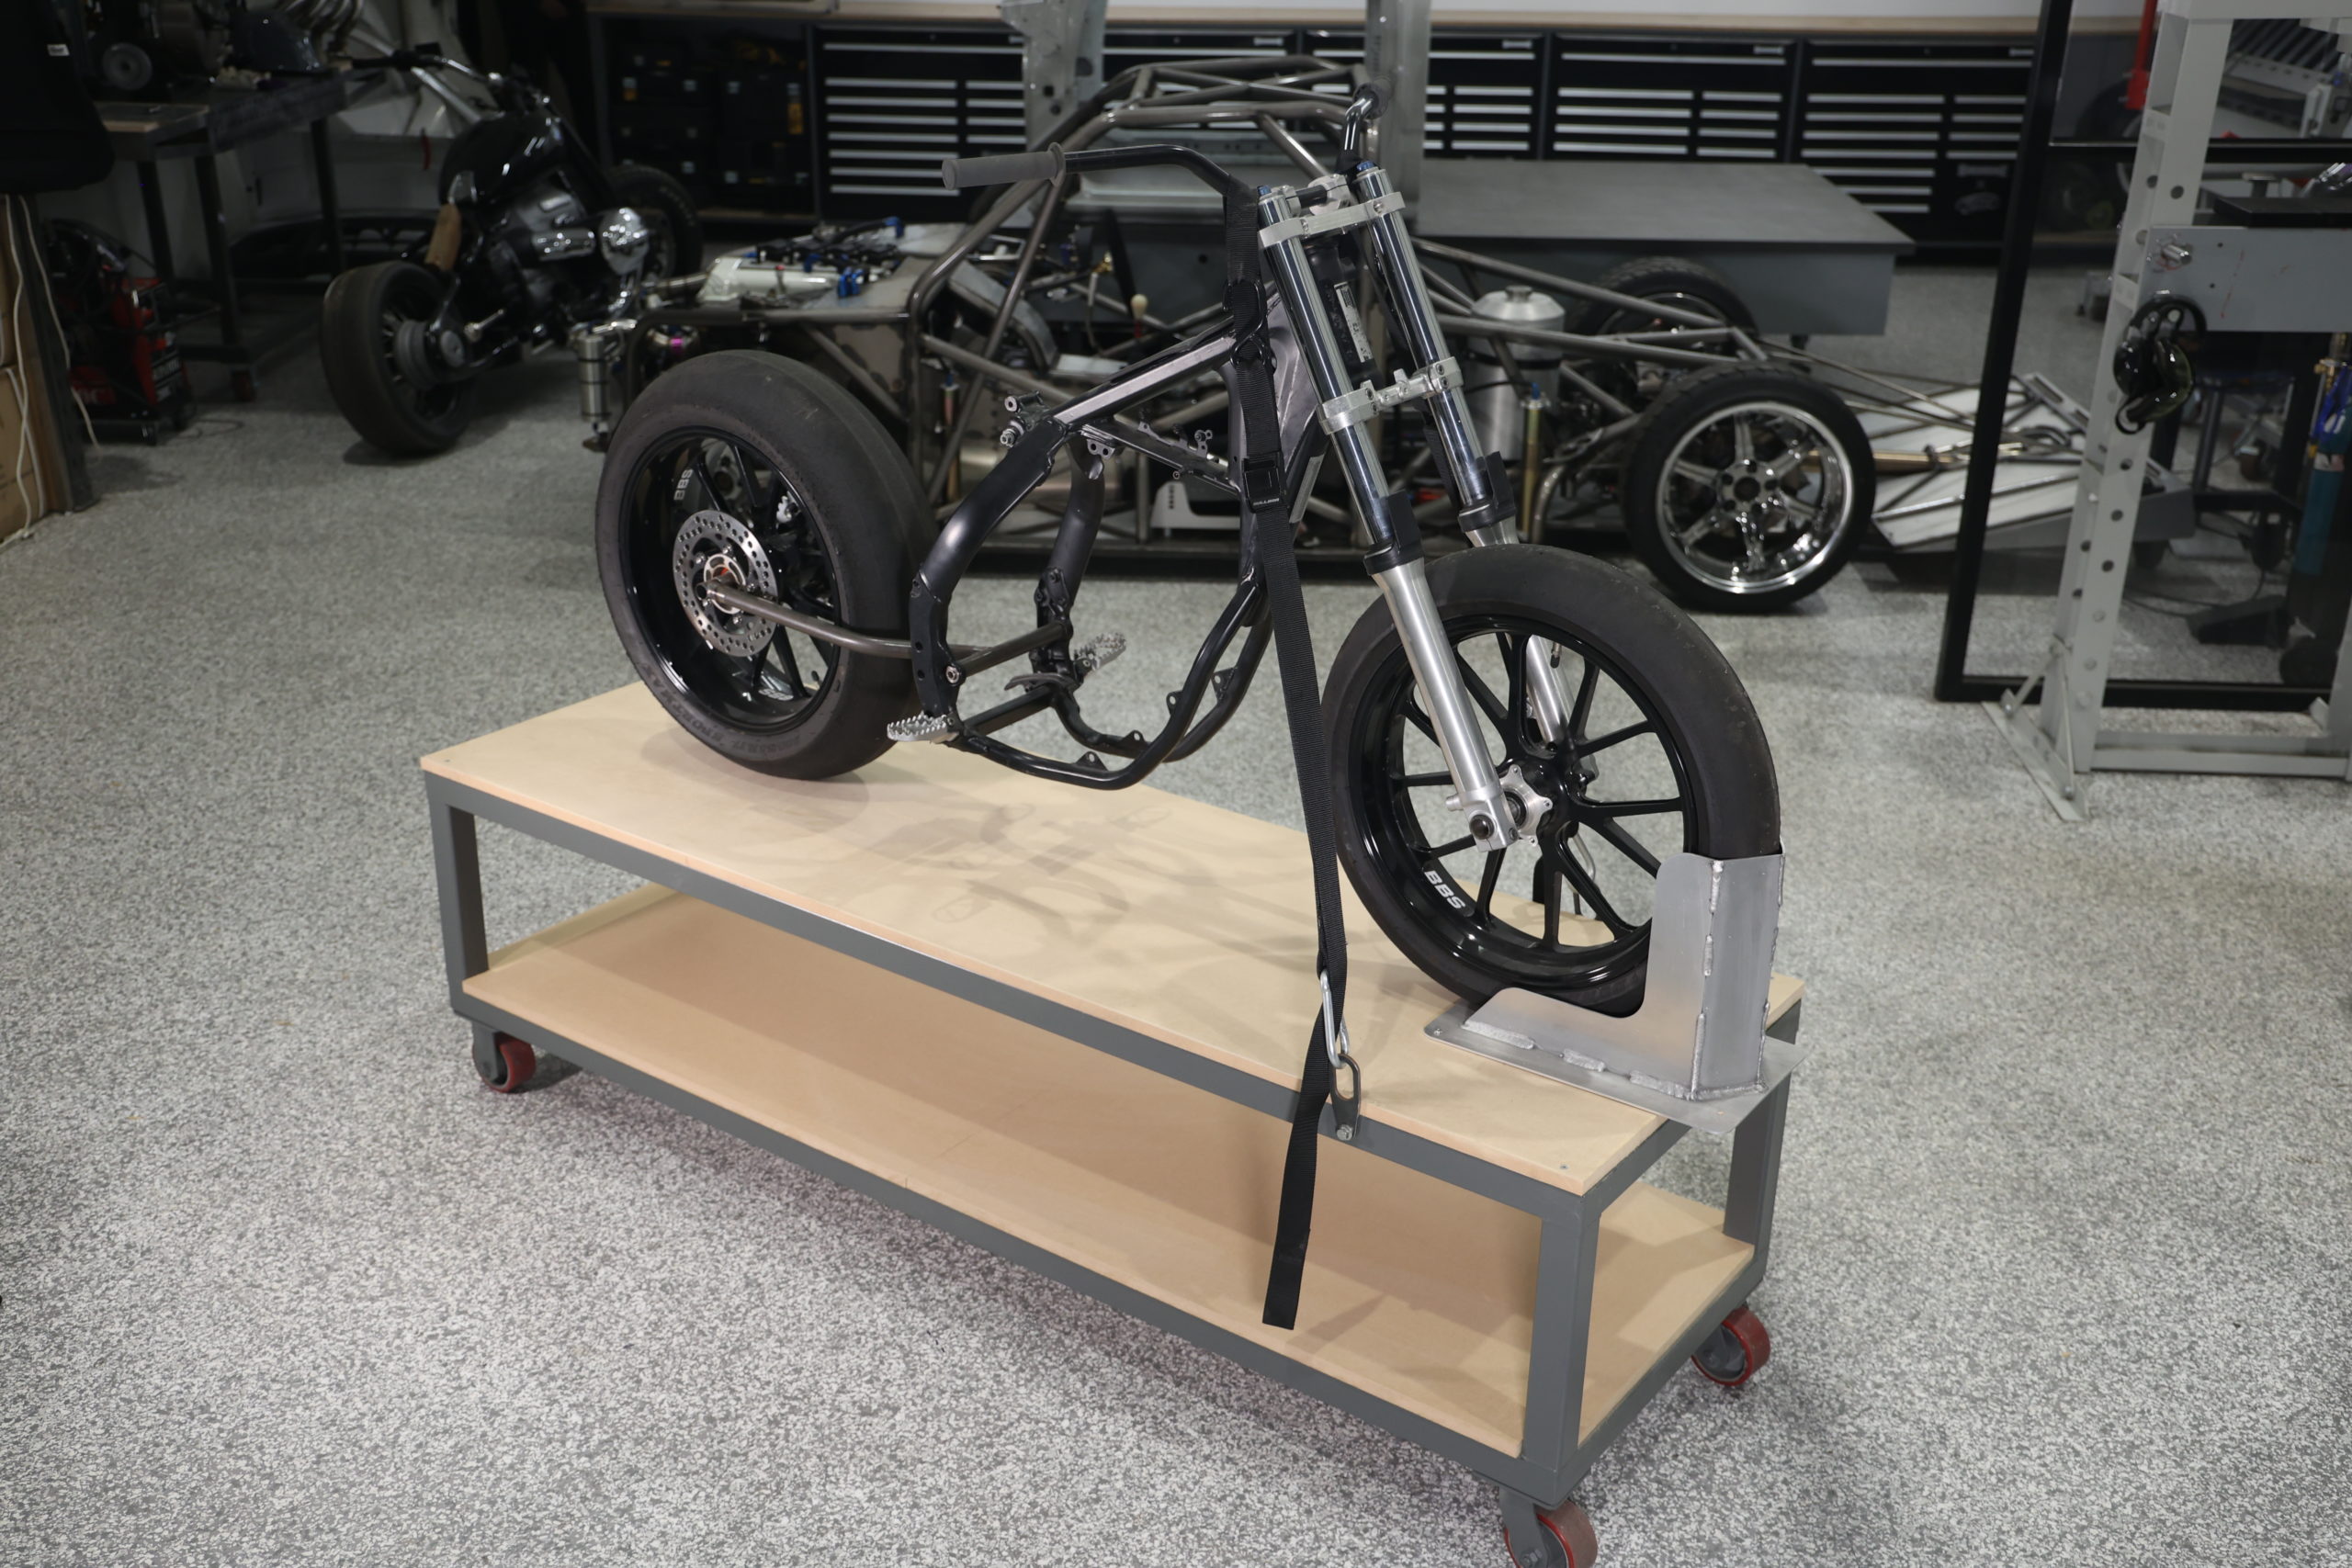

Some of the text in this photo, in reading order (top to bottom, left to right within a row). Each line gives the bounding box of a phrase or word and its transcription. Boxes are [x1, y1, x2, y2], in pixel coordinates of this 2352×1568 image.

[673, 468, 694, 501] BBS
[758, 689, 793, 701] BBS
[1424, 870, 1465, 909] BBS
